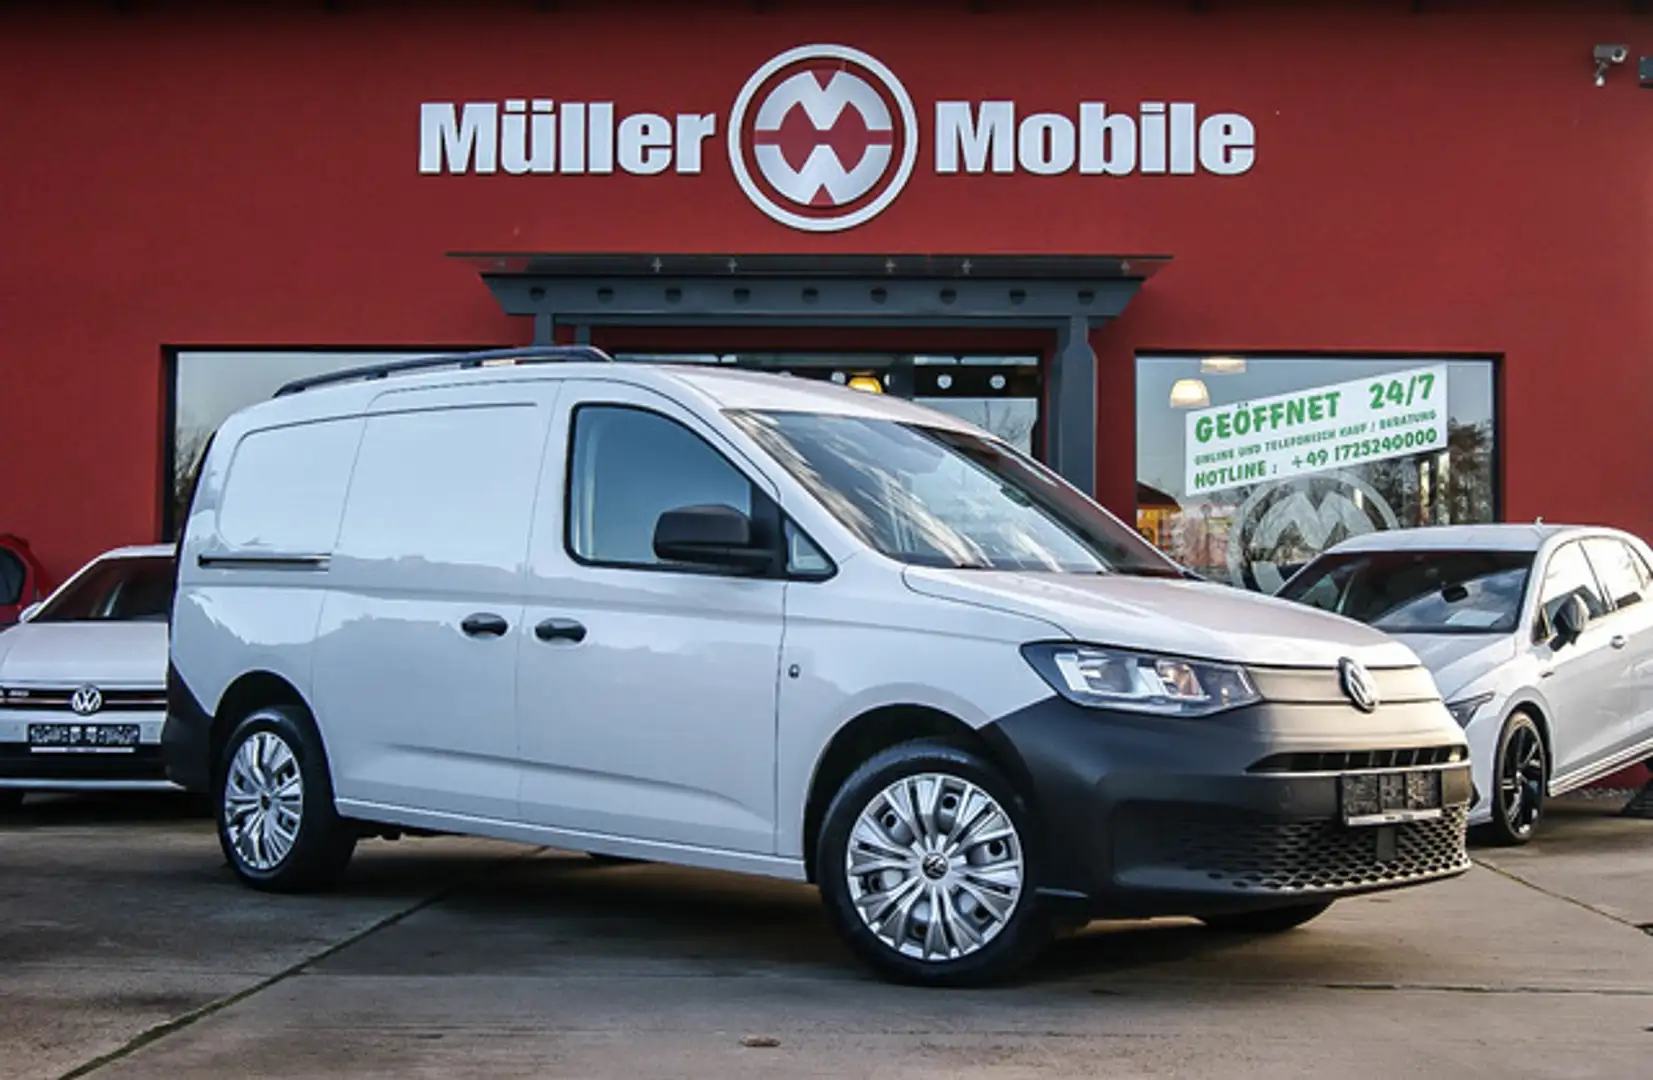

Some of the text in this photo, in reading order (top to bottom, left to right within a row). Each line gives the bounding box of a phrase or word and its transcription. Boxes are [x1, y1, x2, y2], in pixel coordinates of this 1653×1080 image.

[419, 99, 716, 175] Müller
[935, 100, 1256, 175] Mobile
[1195, 373, 1435, 443] GEÖFFNET 24/7
[1195, 460, 1267, 489] HOTLINE
[1292, 449, 1329, 468] +49
[1334, 427, 1438, 461] 1725240000
